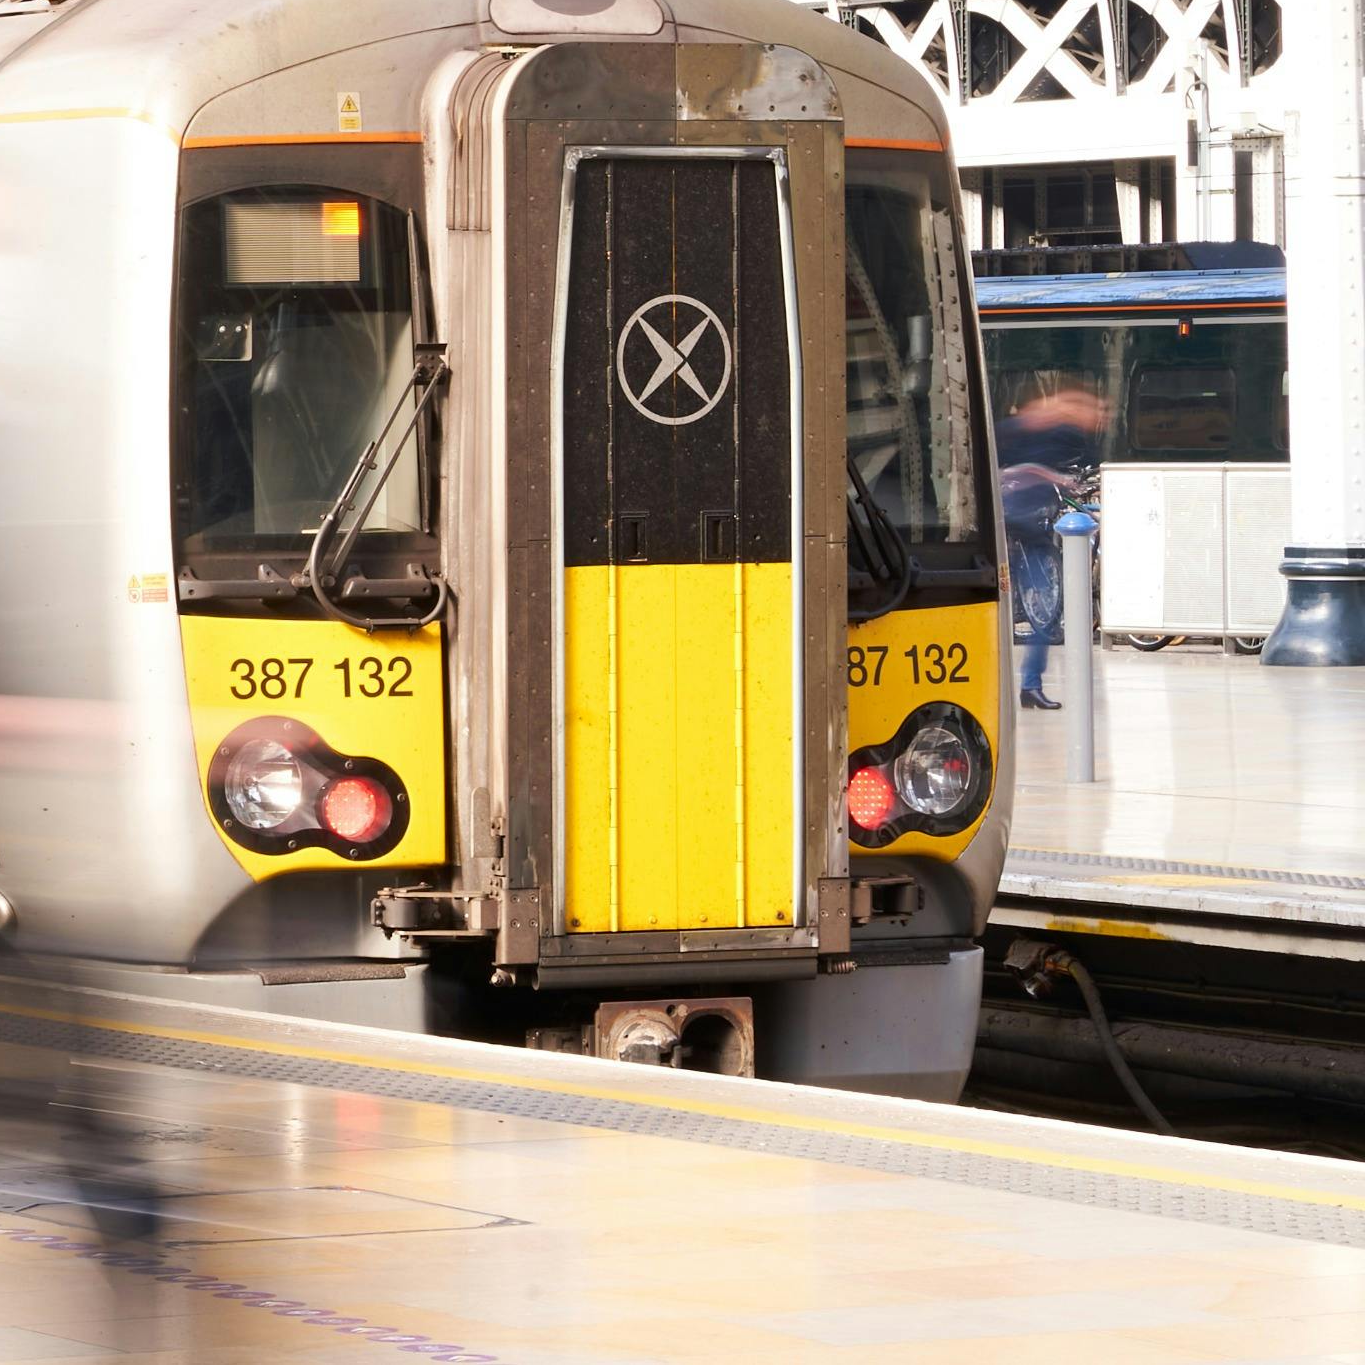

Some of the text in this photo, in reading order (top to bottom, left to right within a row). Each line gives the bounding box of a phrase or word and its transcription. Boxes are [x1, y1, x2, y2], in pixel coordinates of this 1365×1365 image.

[230, 656, 414, 700] 387 132
[847, 642, 970, 688] 87 132
